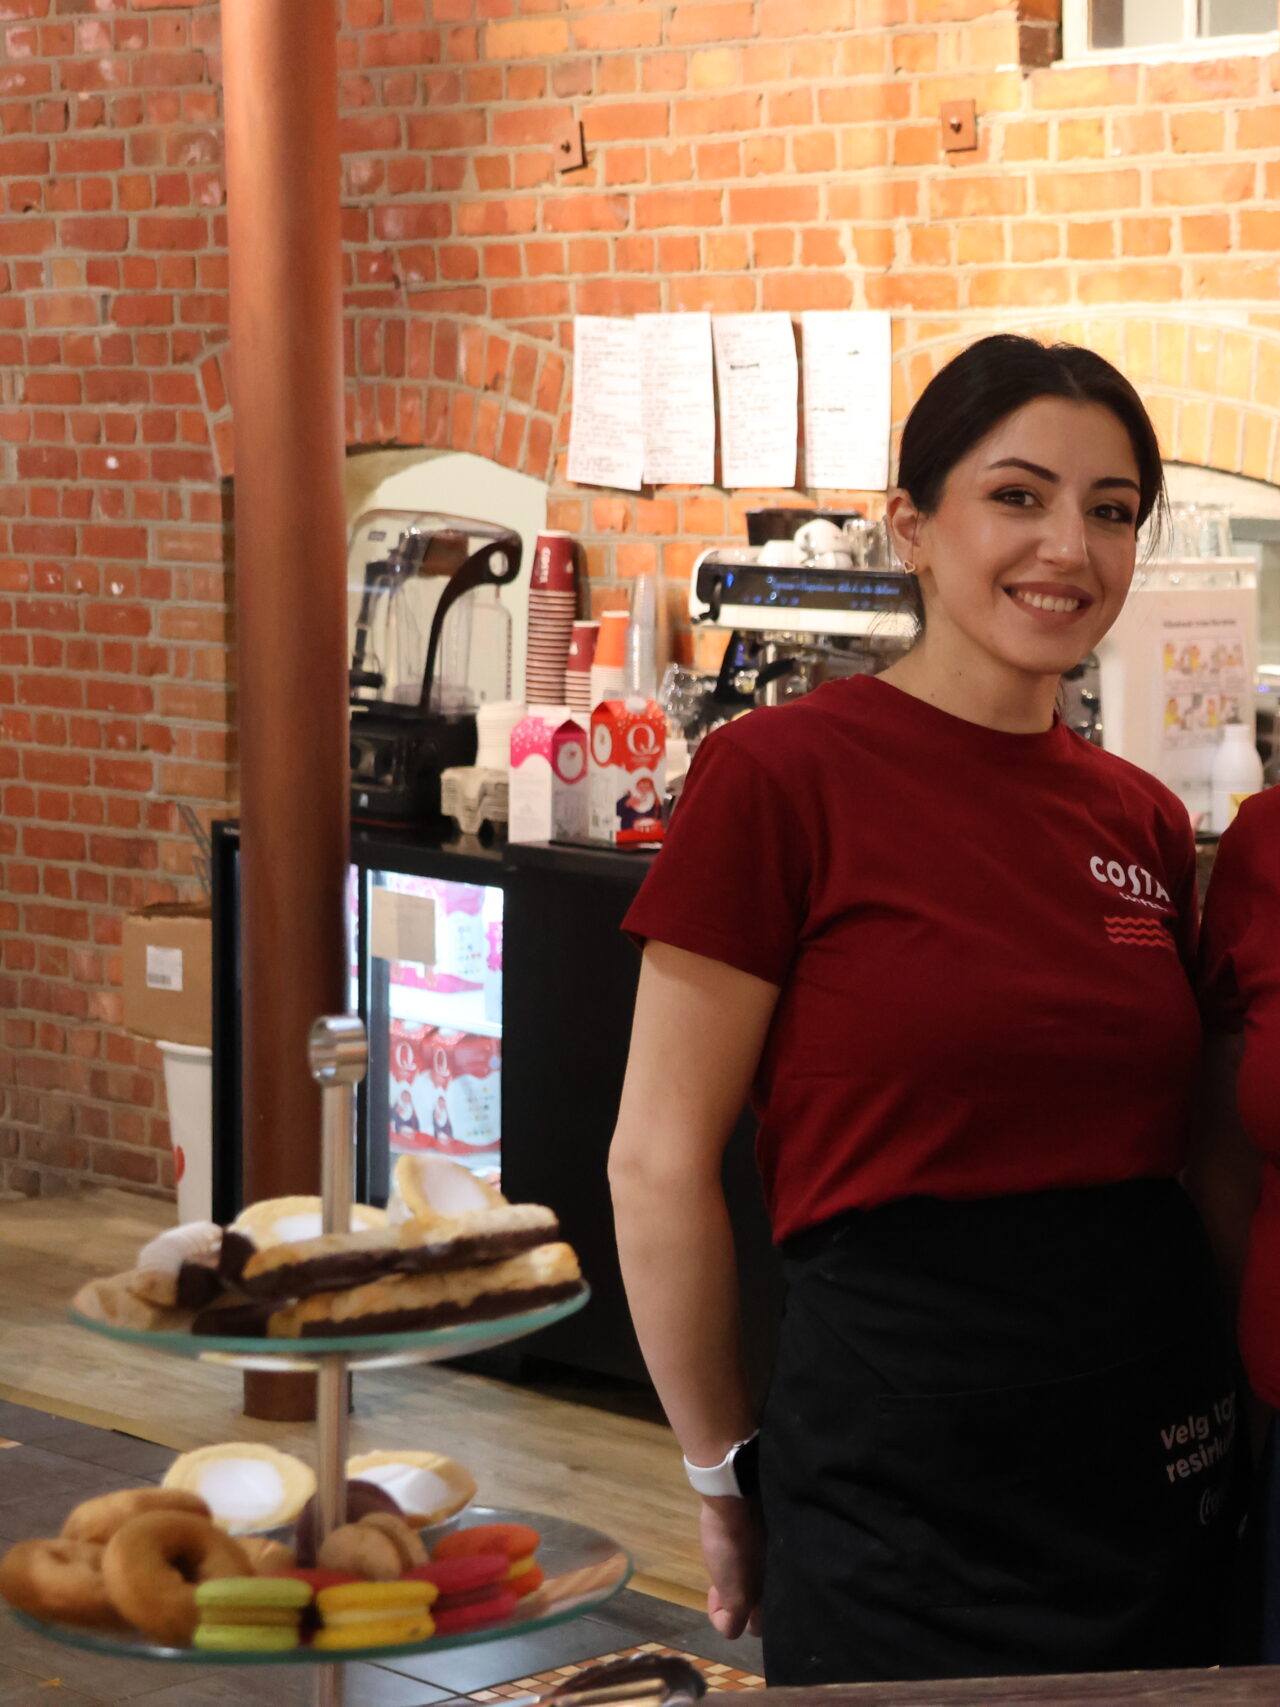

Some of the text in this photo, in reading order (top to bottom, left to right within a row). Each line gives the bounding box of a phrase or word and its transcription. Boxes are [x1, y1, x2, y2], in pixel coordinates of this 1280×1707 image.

[627, 723, 660, 756] Q
[1090, 856, 1171, 903] COSTA
[1160, 1415, 1210, 1450] Velg
